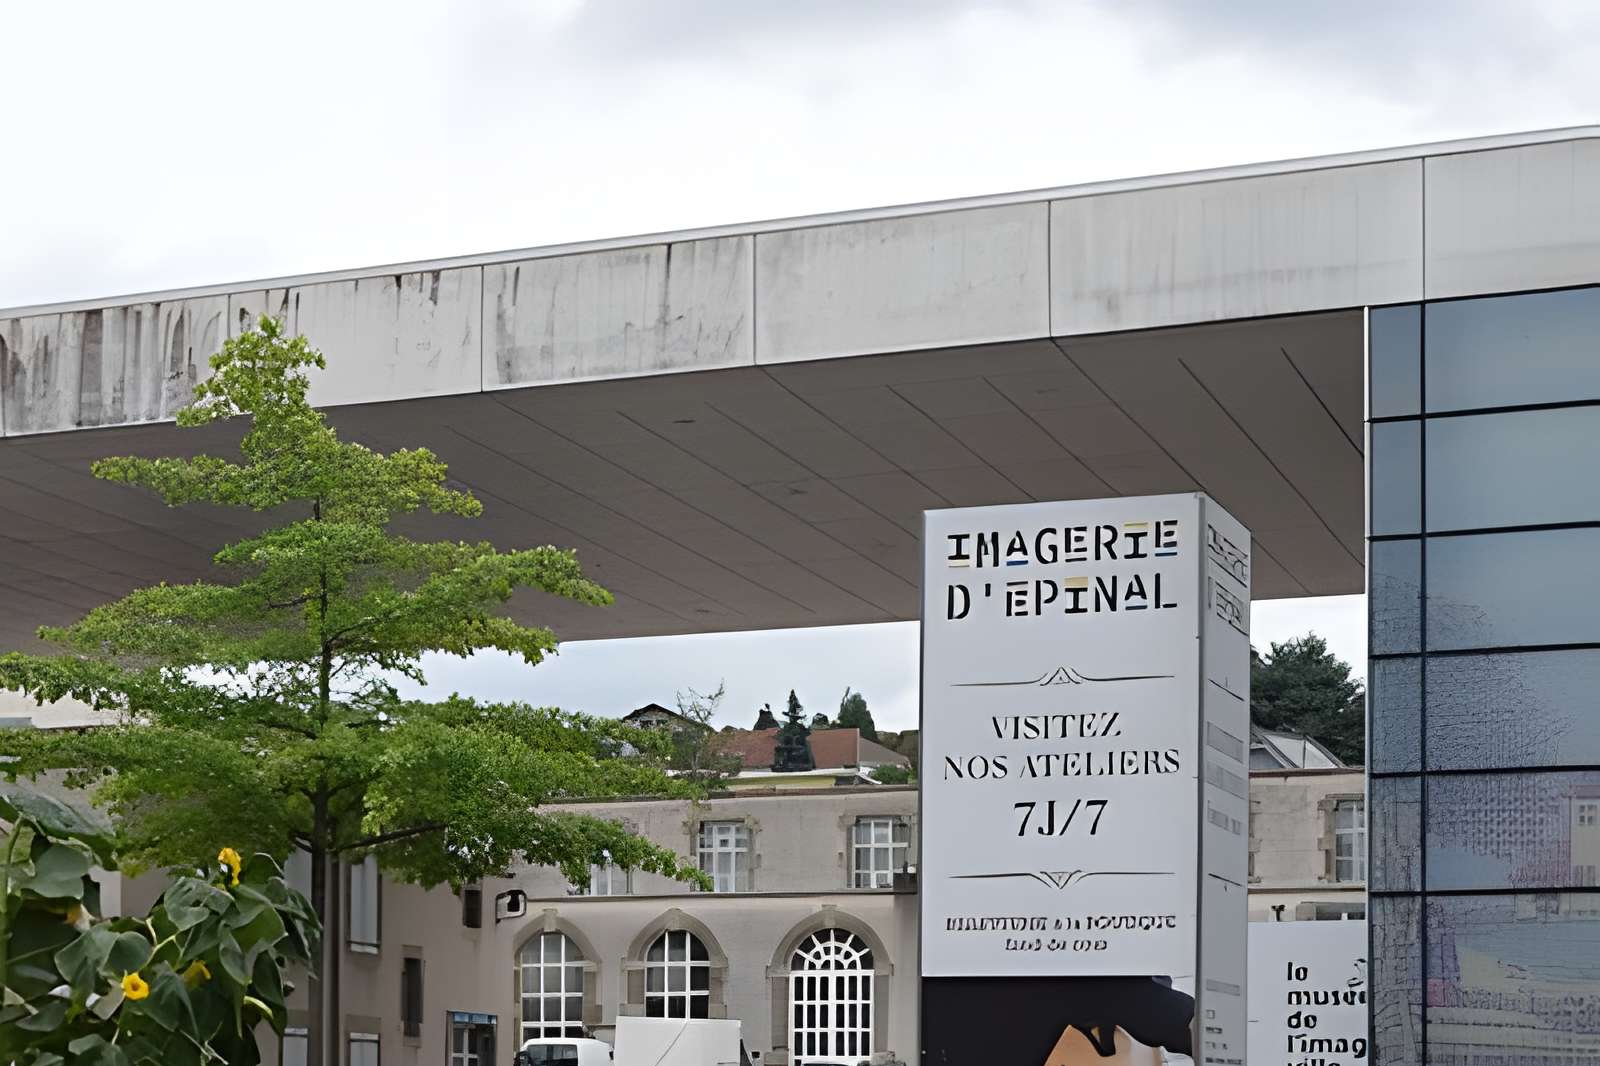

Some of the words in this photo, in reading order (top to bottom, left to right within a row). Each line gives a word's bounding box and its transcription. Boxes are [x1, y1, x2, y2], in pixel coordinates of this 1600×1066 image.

[947, 519, 1178, 568] IMAGERIE
[947, 572, 1177, 620] D'EPINAL
[992, 711, 1122, 740] VISITEZ
[944, 753, 1009, 781] NOS
[1019, 748, 1180, 779] ATELIERS
[1013, 799, 1108, 837] 7J/7
